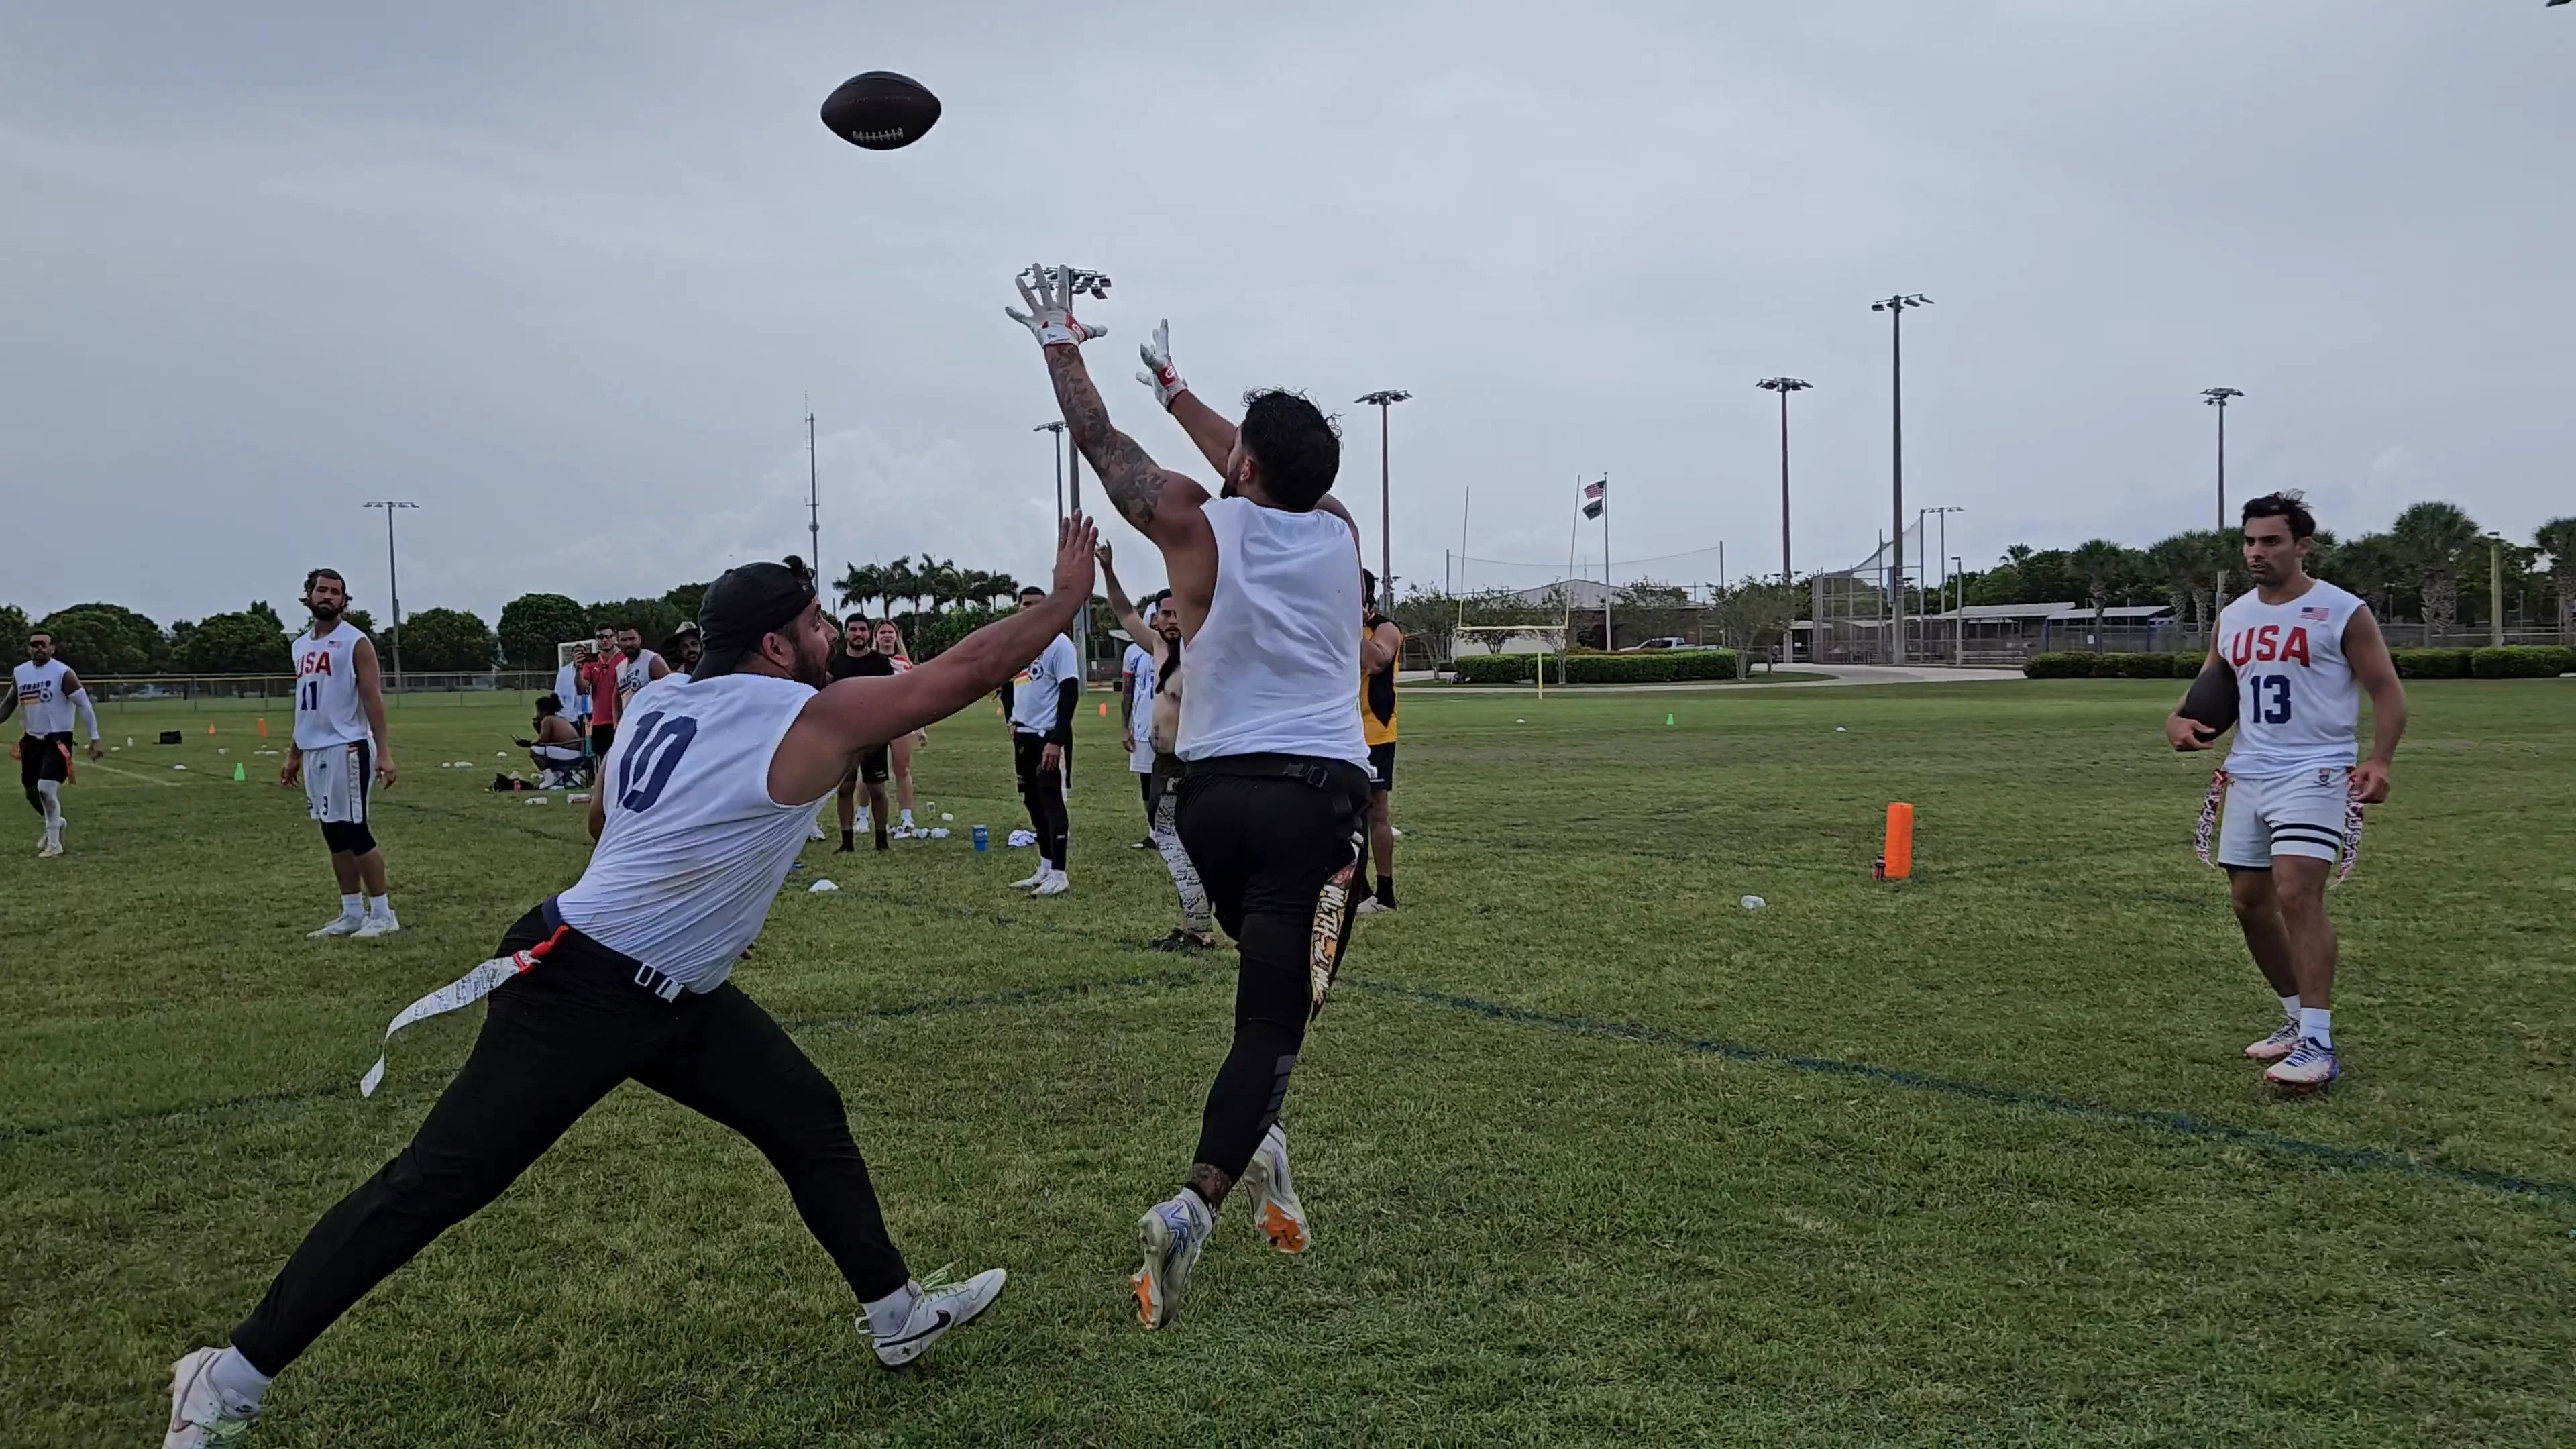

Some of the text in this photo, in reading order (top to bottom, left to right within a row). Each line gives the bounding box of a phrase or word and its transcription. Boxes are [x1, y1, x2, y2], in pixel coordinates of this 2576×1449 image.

[297, 651, 332, 679] USA
[2232, 625, 2310, 667] USA
[301, 680, 317, 710] 11
[2250, 674, 2292, 724] 13
[616, 711, 698, 813] 10
